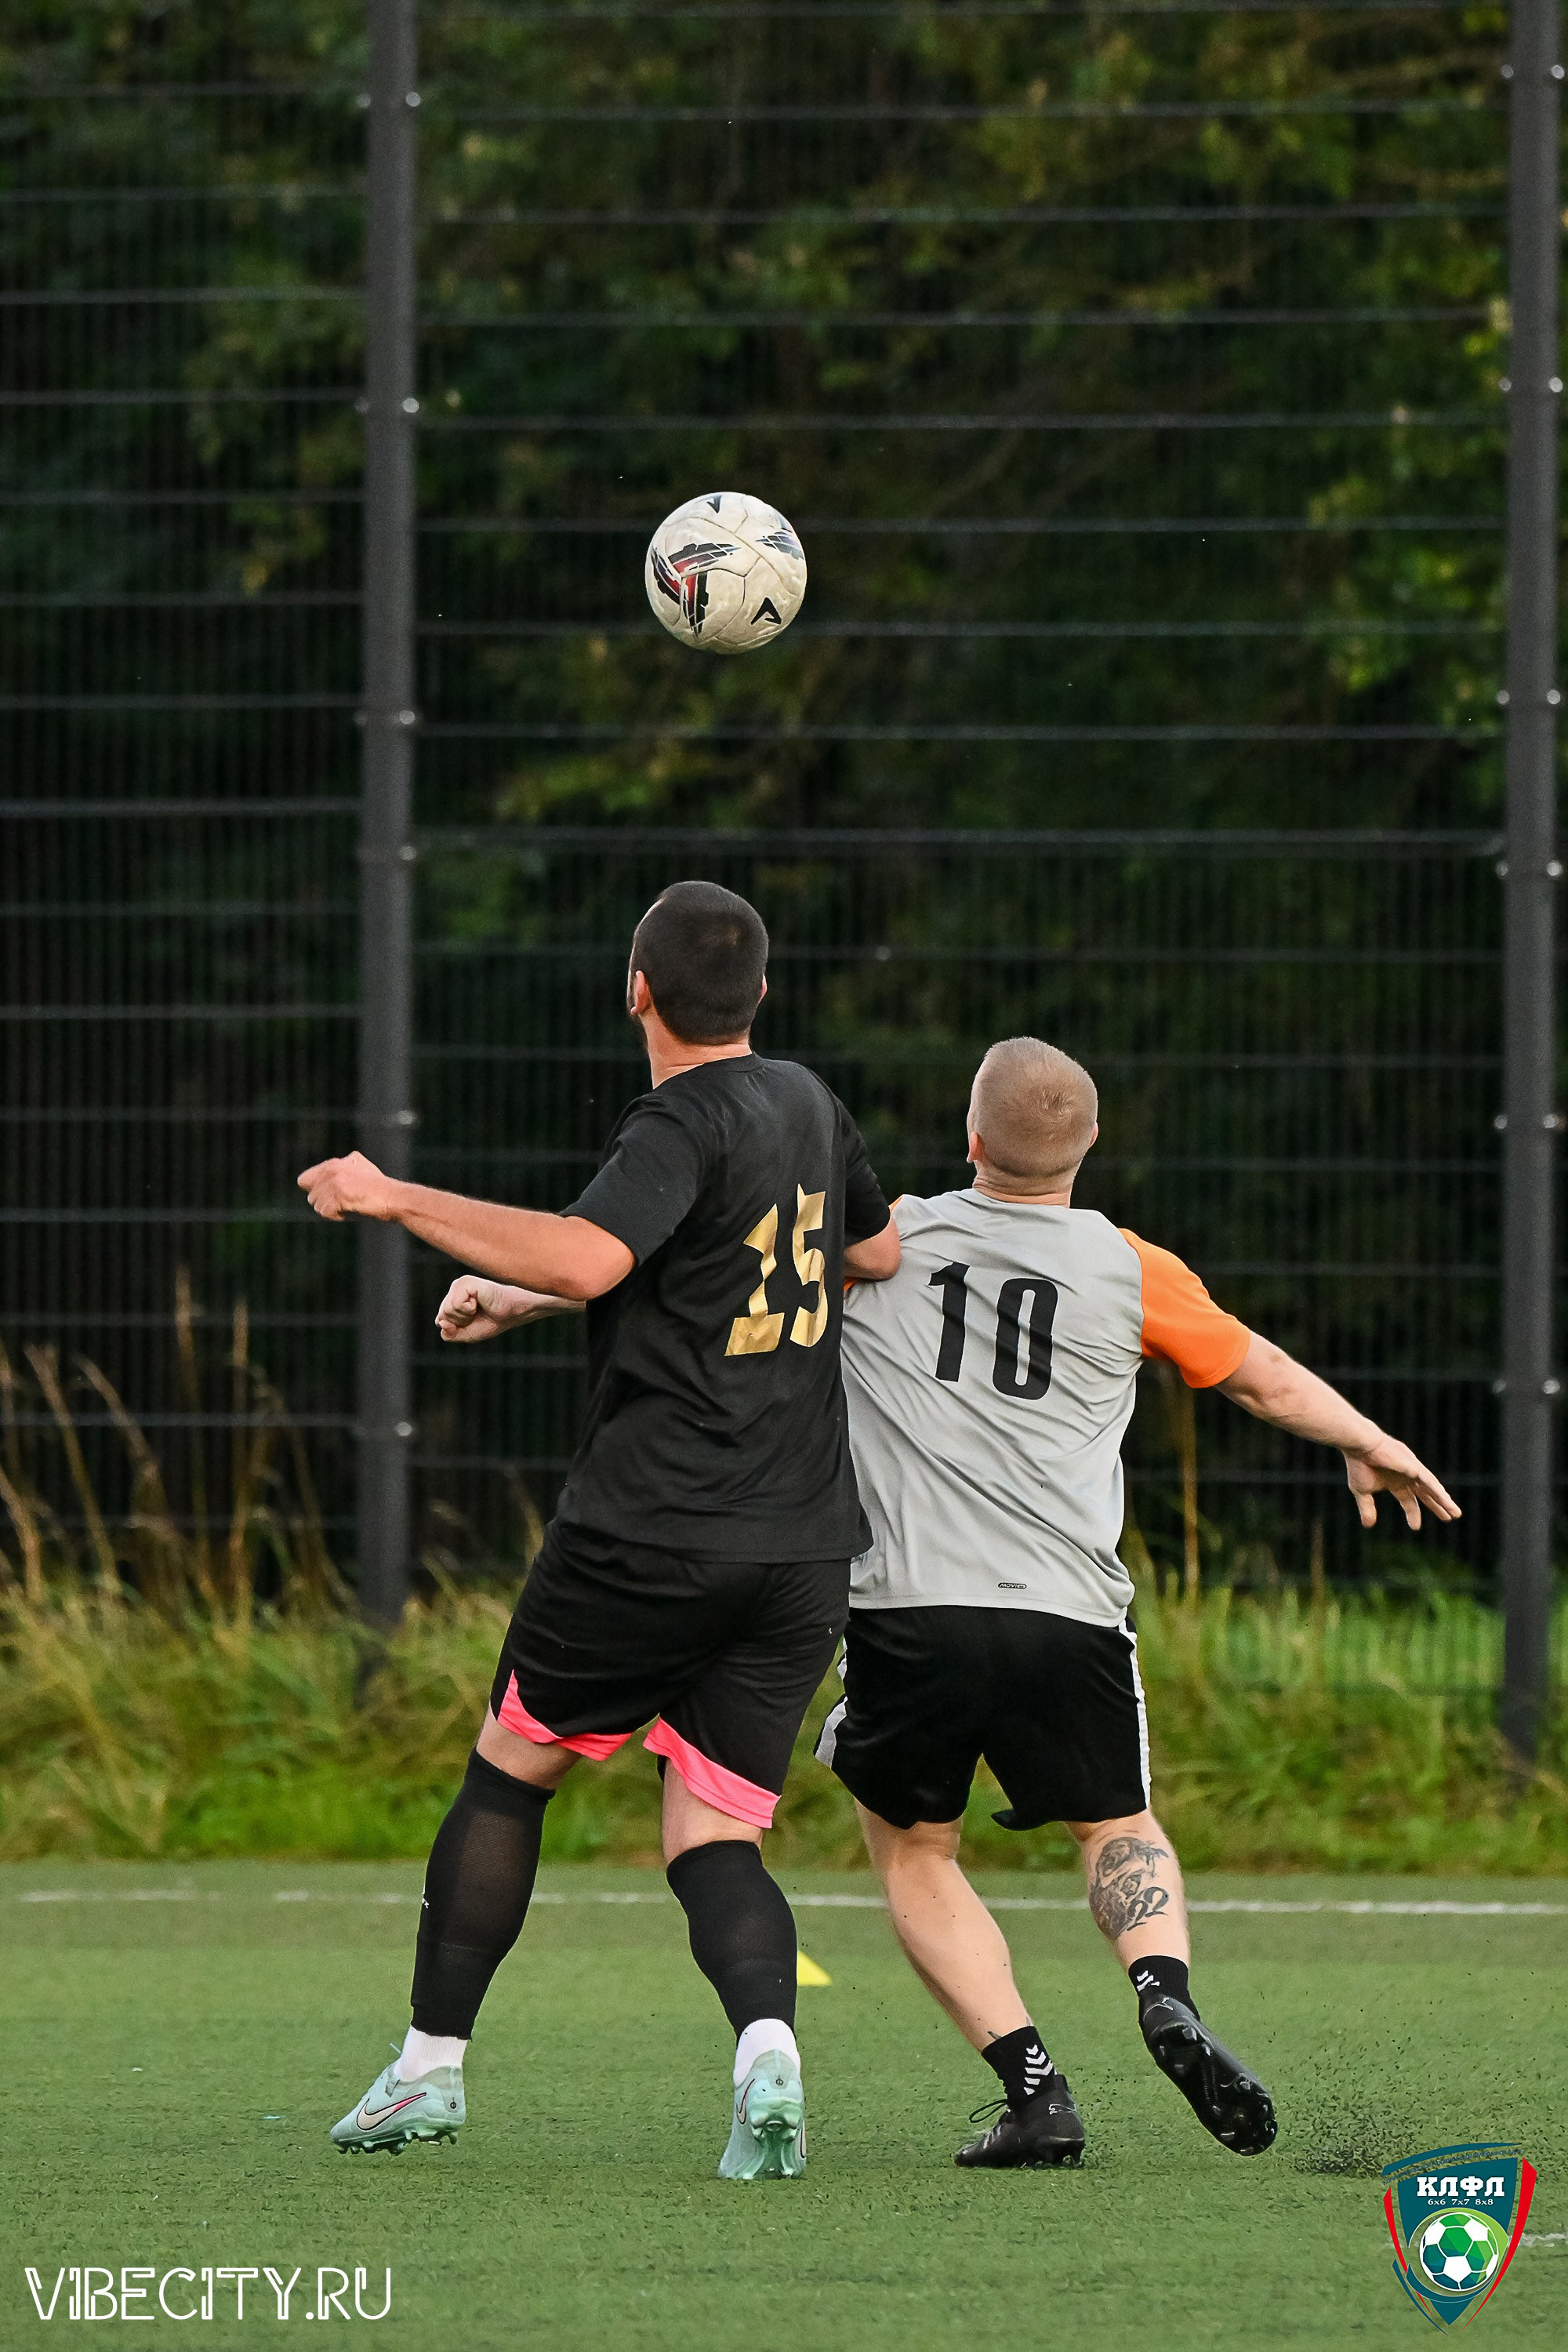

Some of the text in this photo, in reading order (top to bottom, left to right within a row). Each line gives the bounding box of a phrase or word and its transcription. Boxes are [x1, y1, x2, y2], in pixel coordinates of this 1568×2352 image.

[724, 1183, 829, 1357] 15
[928, 1261, 1058, 1400] 10
[1127, 1886, 1170, 1932] 22
